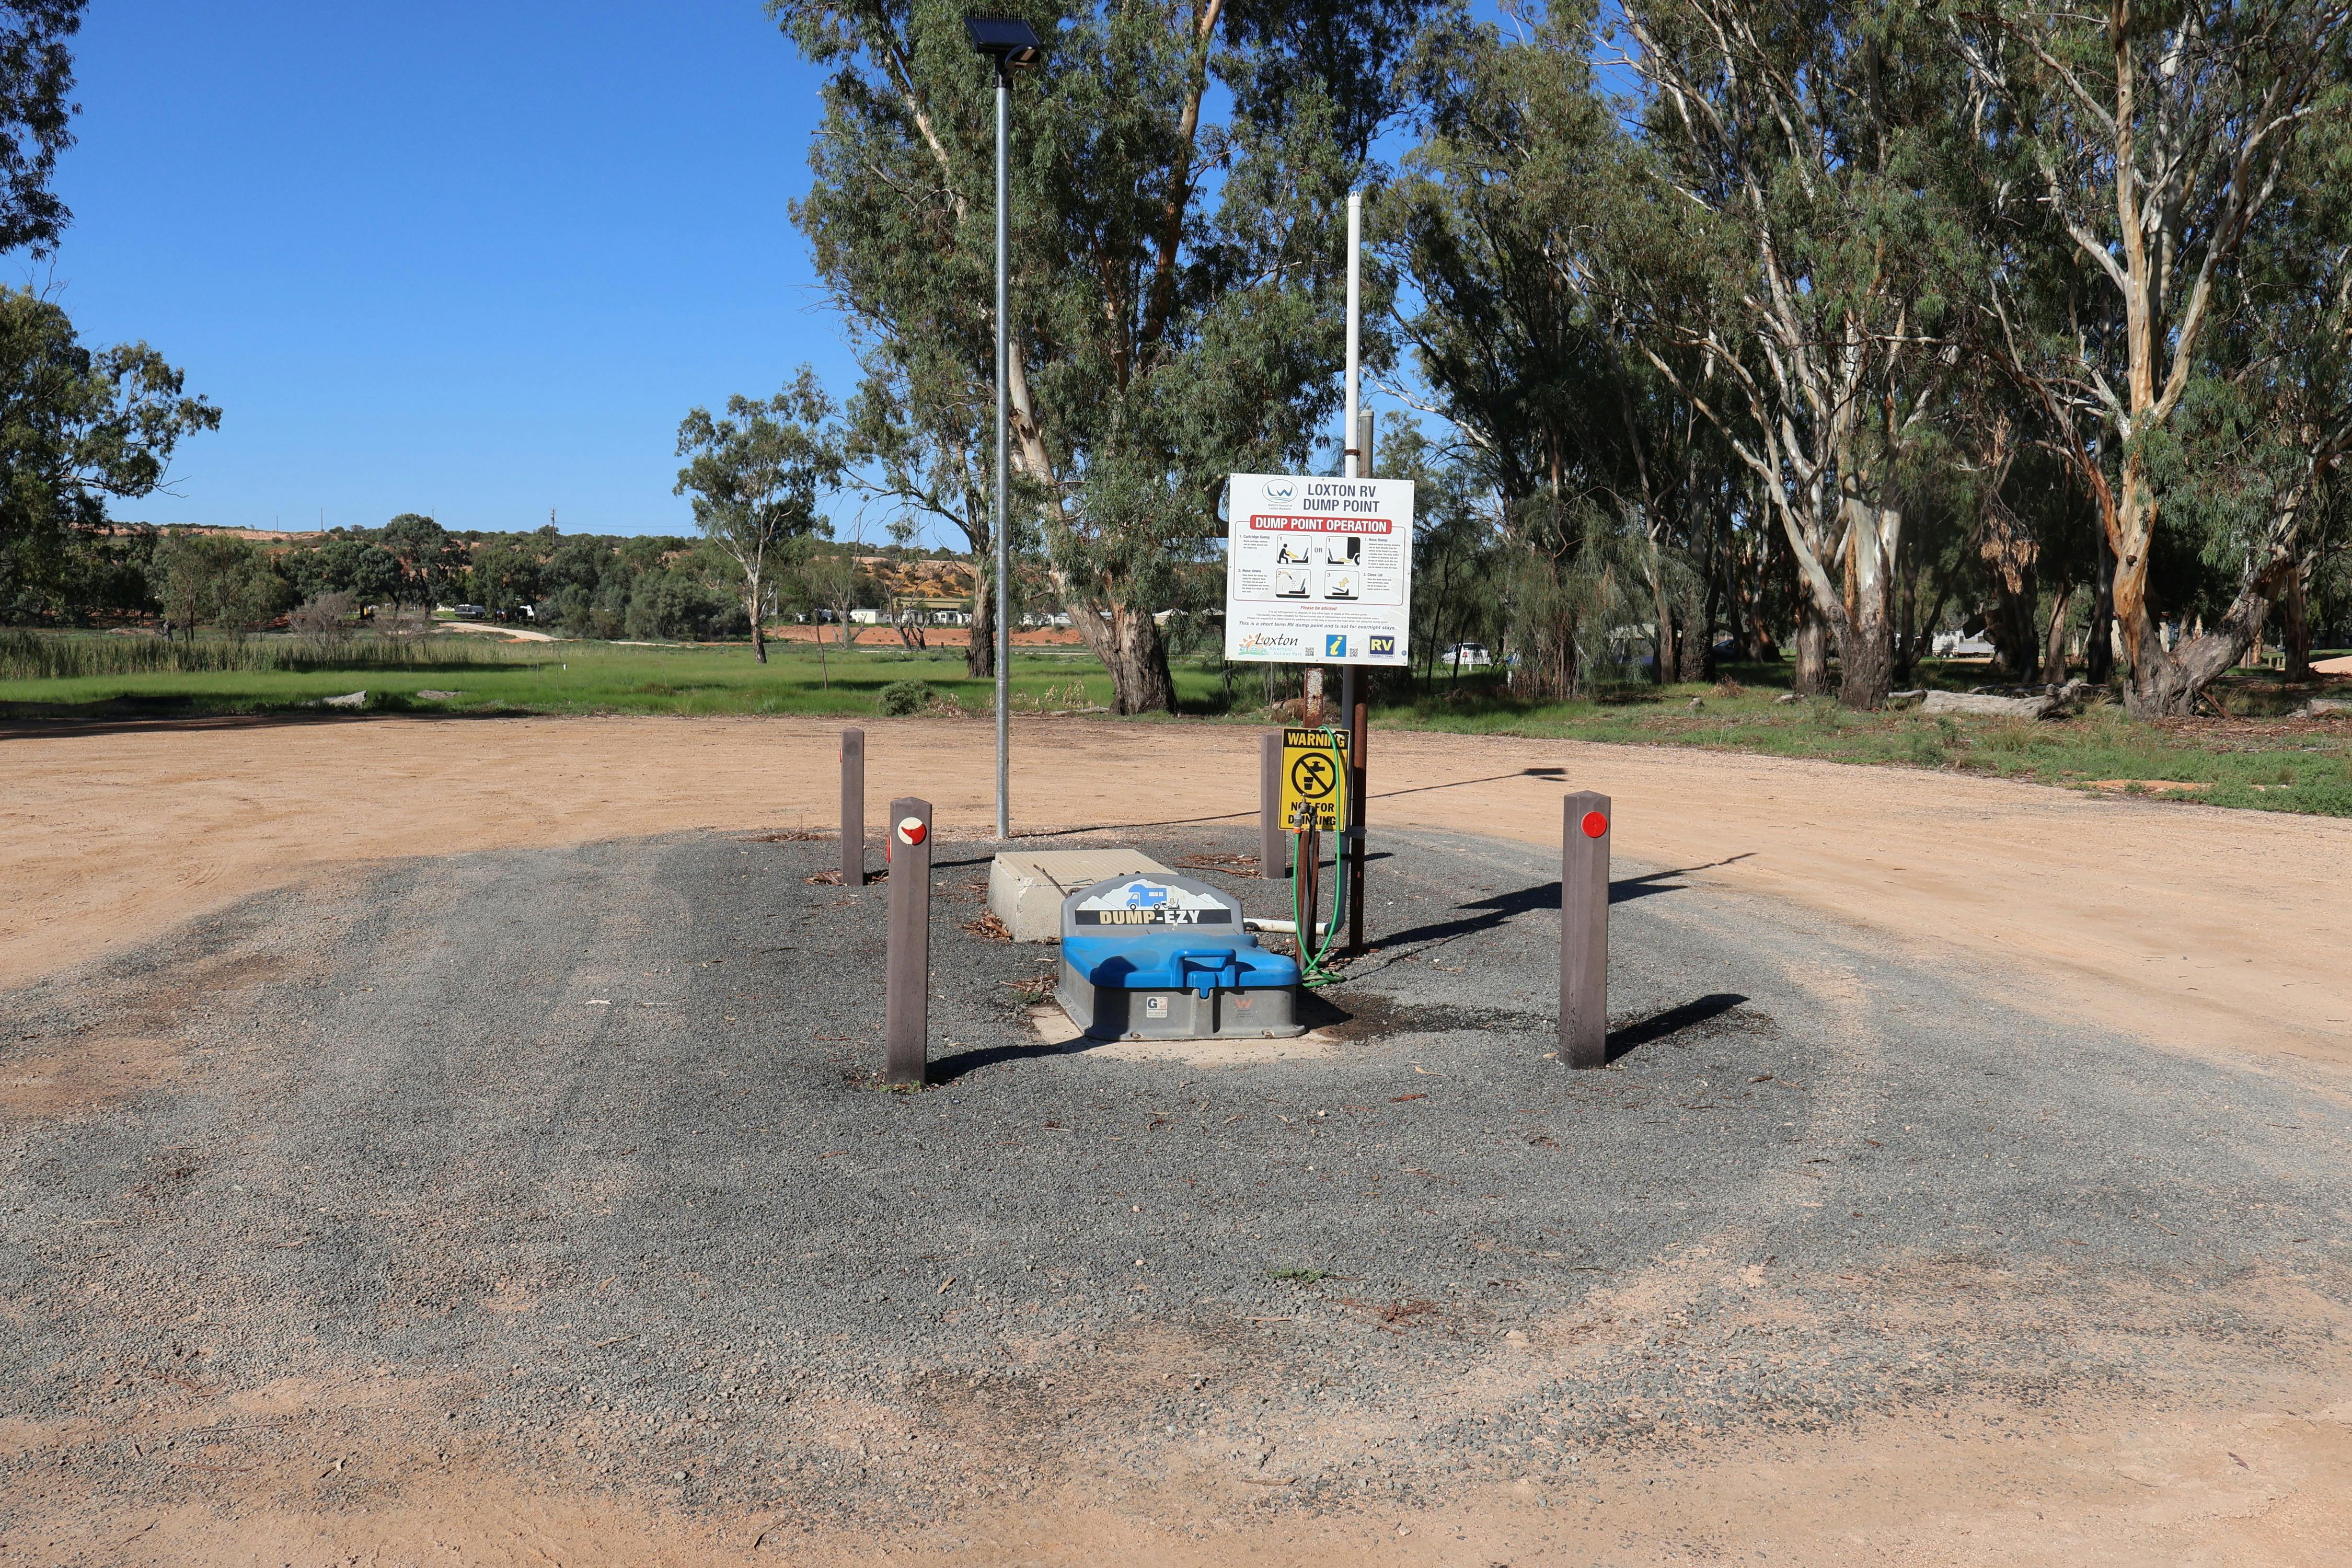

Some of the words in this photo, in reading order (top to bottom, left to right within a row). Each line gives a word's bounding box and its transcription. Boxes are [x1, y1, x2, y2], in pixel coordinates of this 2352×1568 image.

[1308, 483, 1355, 497] LOXTON
[1360, 486, 1376, 498] RV
[1303, 499, 1339, 511] DUMP
[1343, 500, 1380, 513] POINT
[1255, 517, 1288, 529] DUMP
[1290, 518, 1324, 530] POINT
[1326, 520, 1387, 532] OPERATION
[1255, 632, 1298, 646] Loxton
[1371, 639, 1393, 651] RV
[1315, 802, 1335, 812] FOR
[1099, 910, 1200, 924] DUMP-EZY
